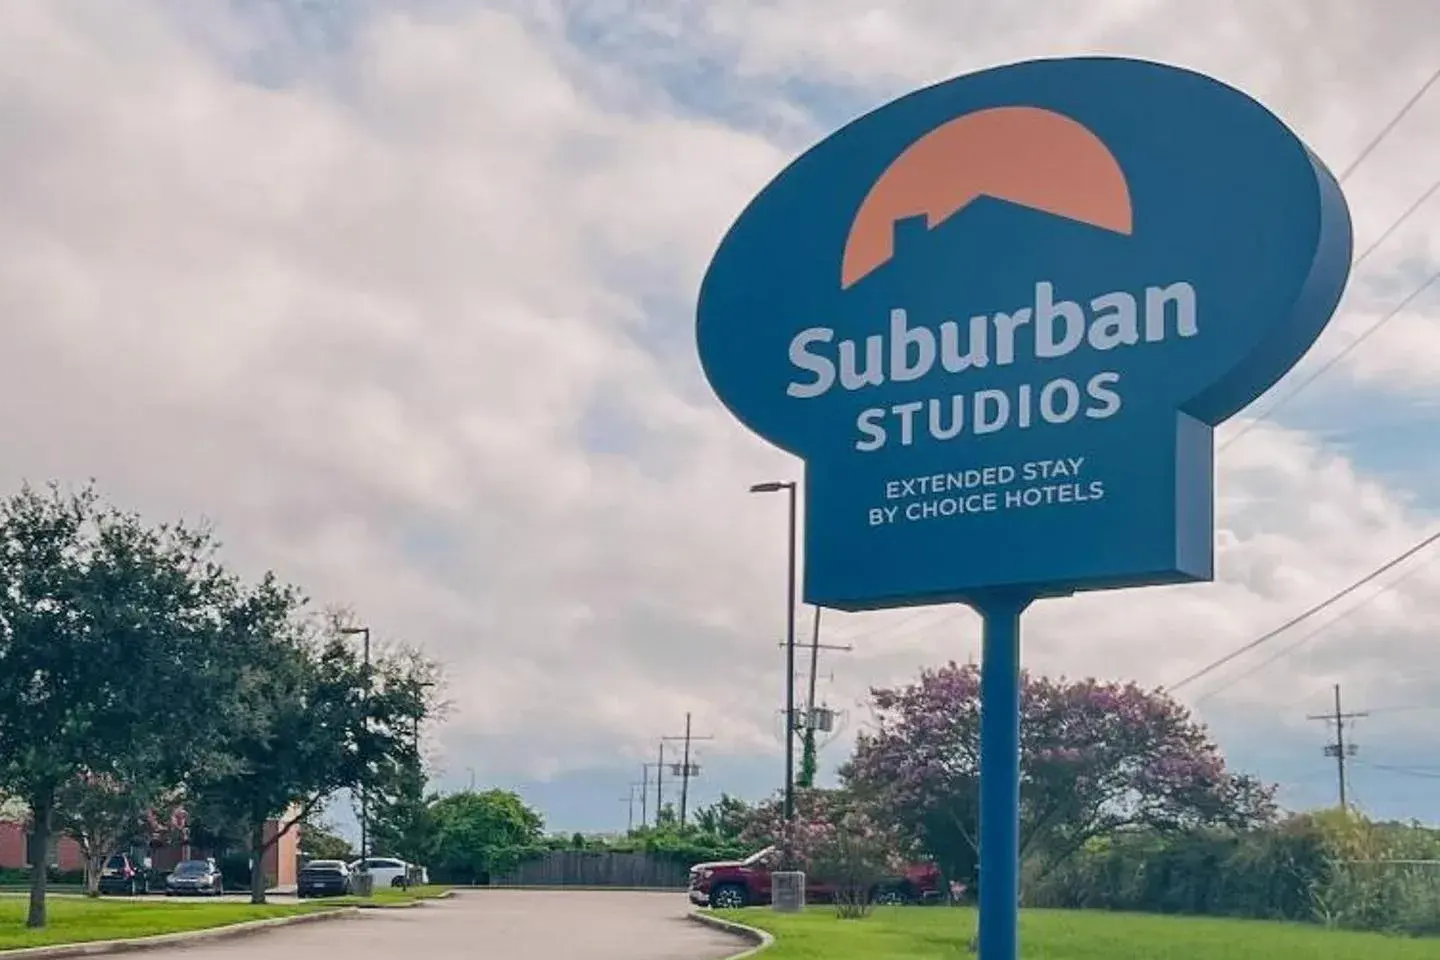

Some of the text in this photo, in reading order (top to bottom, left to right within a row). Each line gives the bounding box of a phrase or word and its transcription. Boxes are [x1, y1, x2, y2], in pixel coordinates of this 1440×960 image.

[786, 281, 1198, 400] Suburban
[854, 371, 1122, 452] STUDIOS
[869, 481, 1105, 525] BY CHOICE HOTELS
[886, 457, 1085, 499] EXTENDED STAY
